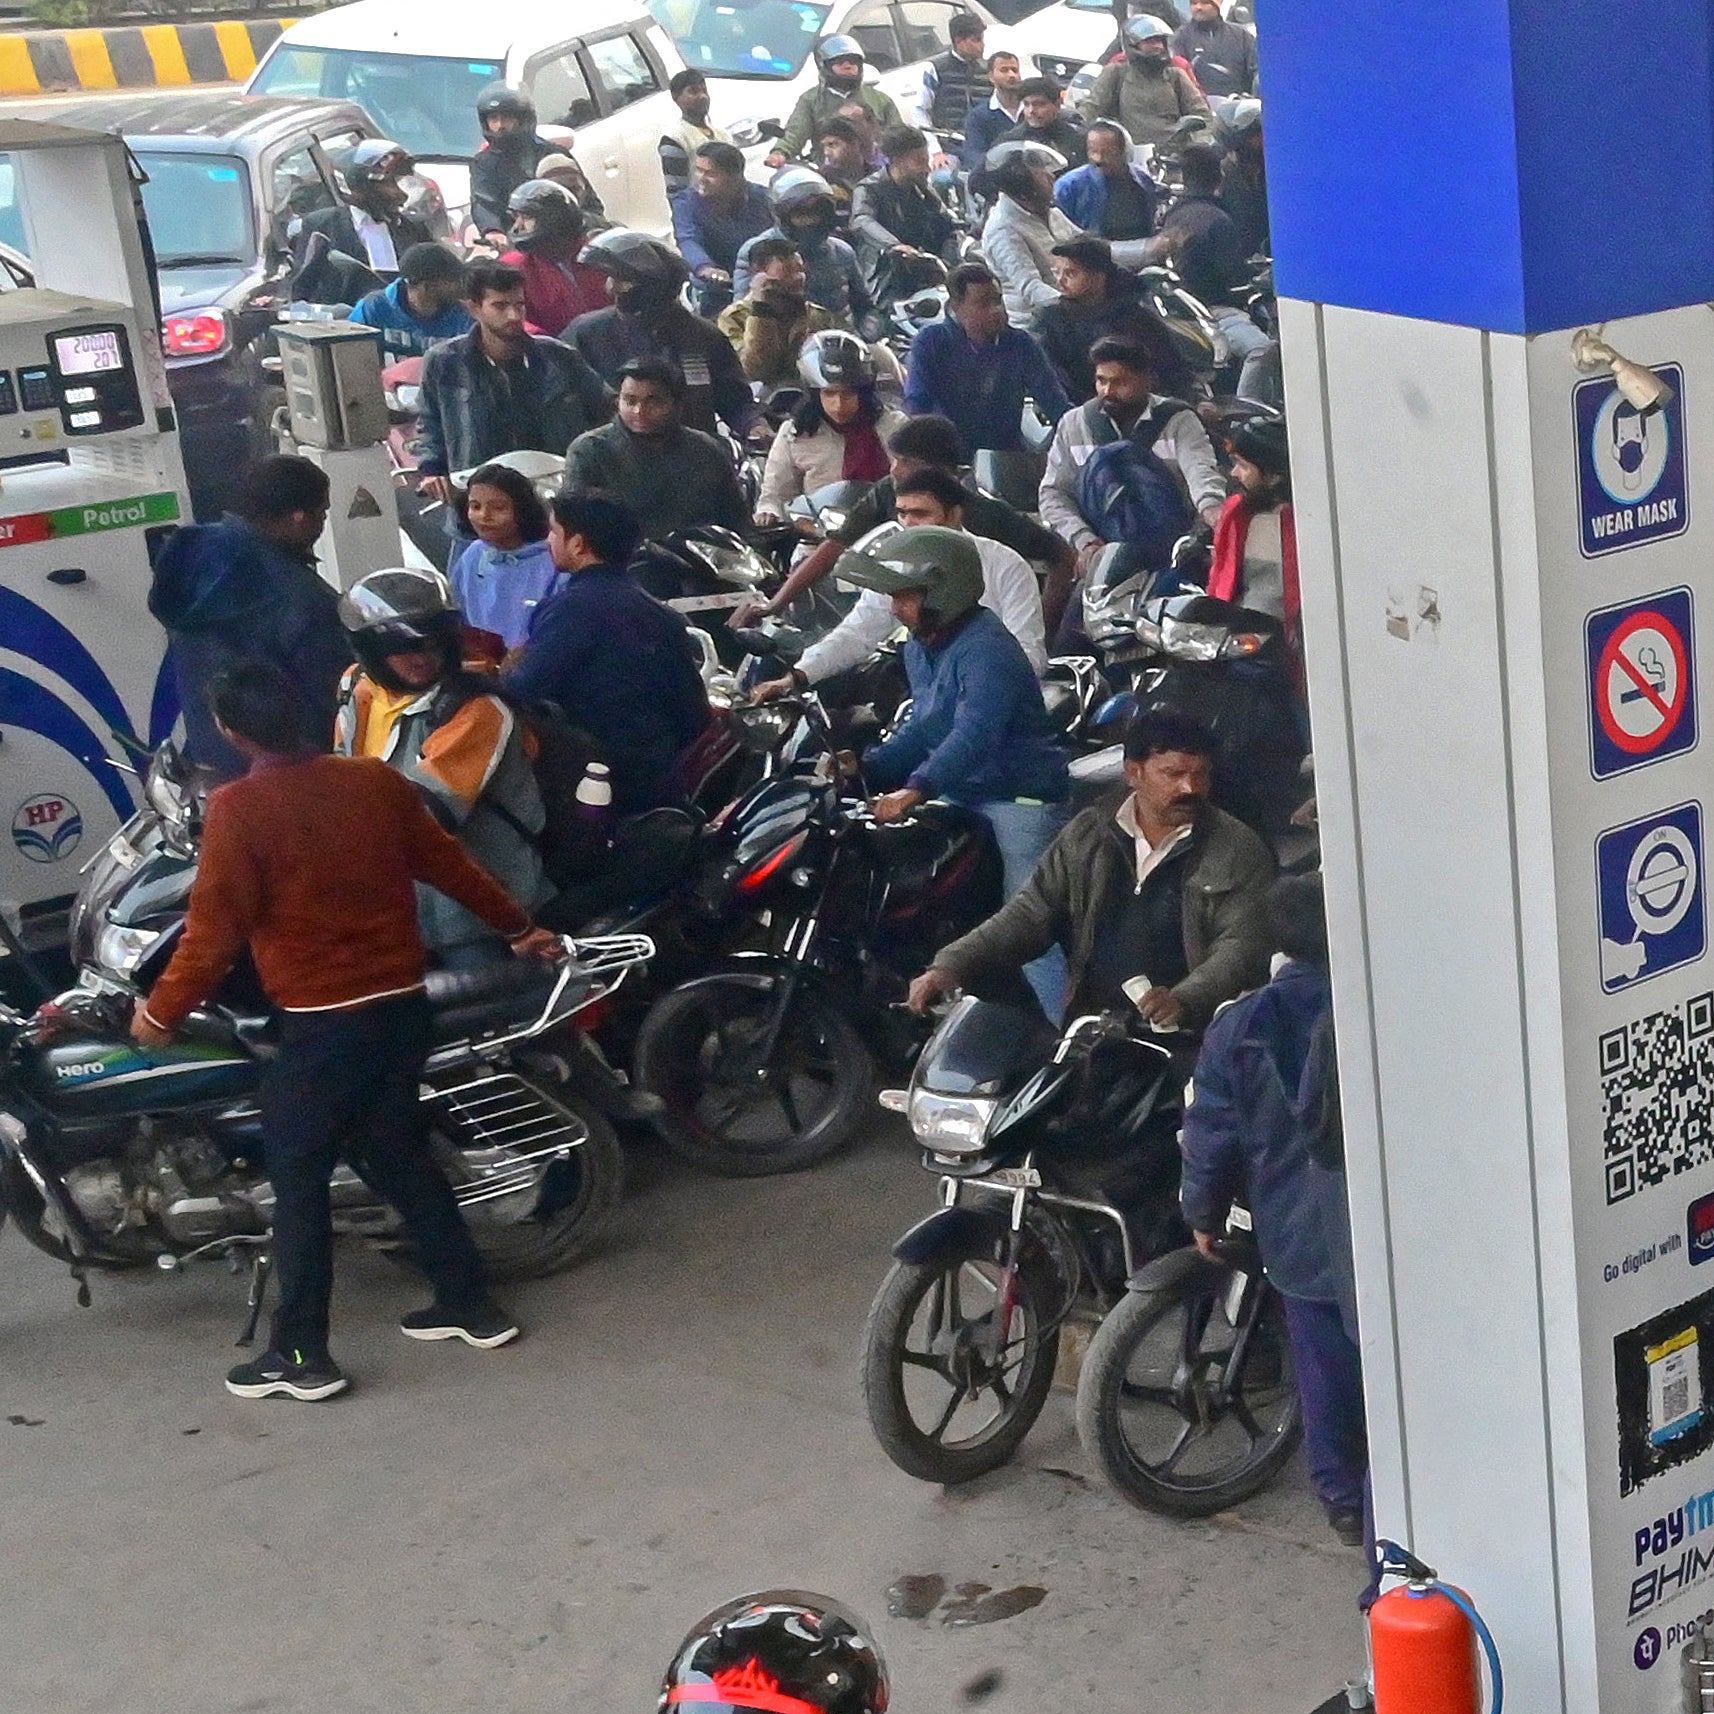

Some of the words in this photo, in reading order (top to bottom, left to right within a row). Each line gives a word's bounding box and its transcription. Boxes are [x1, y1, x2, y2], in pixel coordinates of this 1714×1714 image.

[83, 502, 145, 529] Petrol
[1591, 509, 1634, 539] WEAR
[1636, 498, 1677, 527] MASK
[25, 801, 63, 827] HP
[1604, 1261, 1619, 1283] Go
[1621, 1243, 1657, 1277] digital
[1660, 1233, 1681, 1260] with
